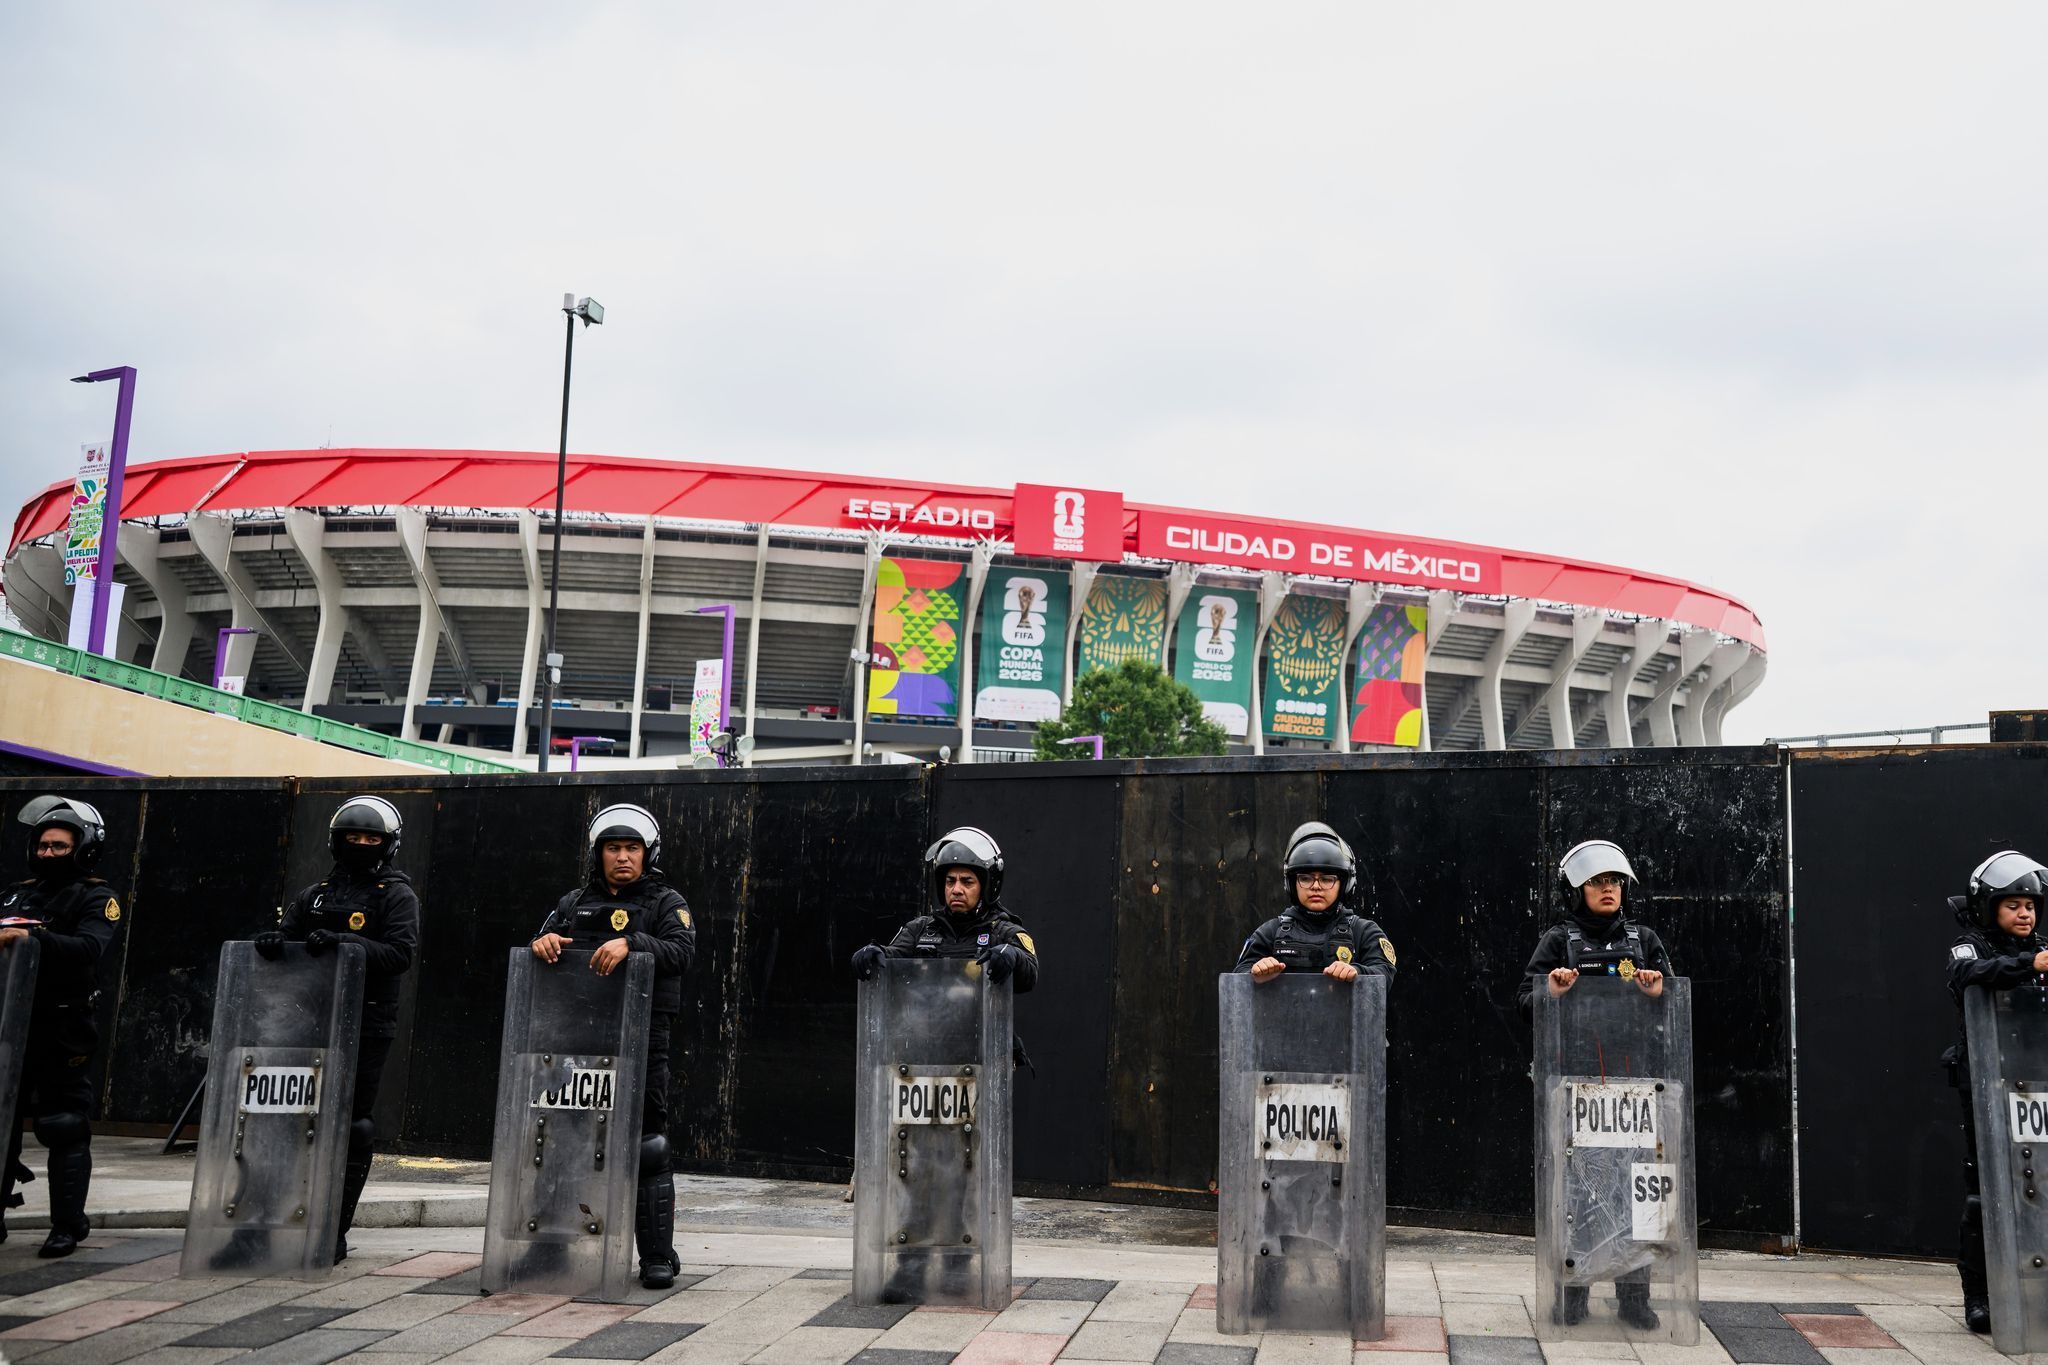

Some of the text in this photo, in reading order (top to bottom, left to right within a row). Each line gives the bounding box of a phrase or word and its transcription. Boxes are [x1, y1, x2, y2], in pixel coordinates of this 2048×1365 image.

[849, 498, 995, 530] ESTADIO
[67, 548, 98, 558] LA PELOTA
[1166, 526, 1481, 583] CIUDAD DE MÉXICO
[1014, 631, 1034, 640] FIFA
[1000, 647, 1044, 662] COPA
[1206, 647, 1224, 656] FIFA
[999, 659, 1043, 670] MUNDIAL
[1193, 661, 1233, 672] WORLD CUP
[998, 670, 1043, 682] 2026
[1192, 669, 1233, 682] 2026
[1274, 713, 1326, 727] CIUDAD DE
[245, 1074, 316, 1106] POLICIA
[533, 1072, 612, 1108] OLICIA
[899, 1084, 971, 1118] POLICIA
[1266, 1104, 1339, 1141] POLICIA
[1576, 1097, 1653, 1133] POLICIA
[1634, 1175, 1673, 1202] SSP
